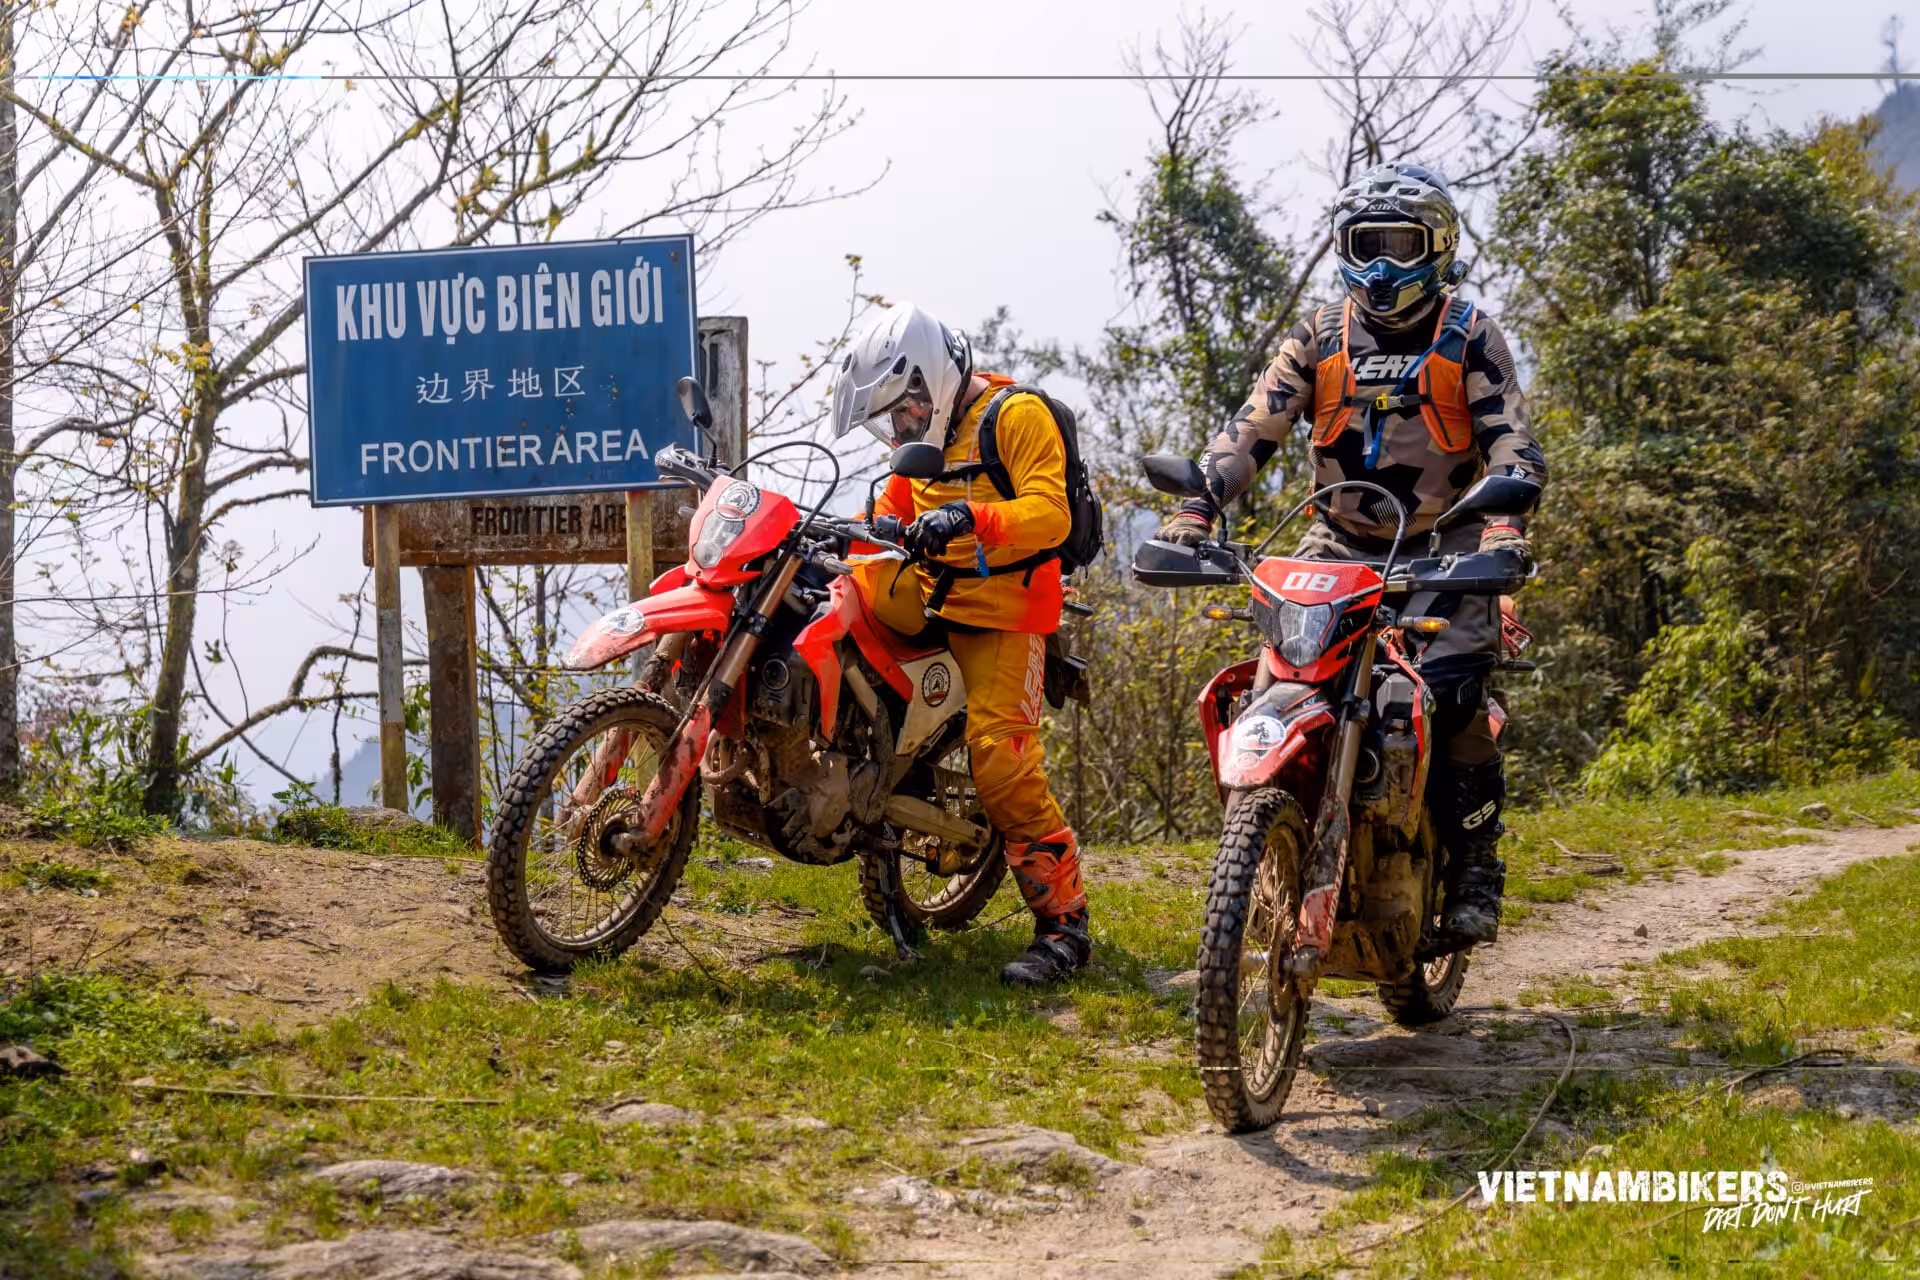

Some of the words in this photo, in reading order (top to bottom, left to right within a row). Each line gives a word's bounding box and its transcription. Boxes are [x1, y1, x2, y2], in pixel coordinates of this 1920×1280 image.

[336, 281, 407, 342] KHU
[416, 272, 486, 345] VỰC
[496, 262, 581, 332] BIÊN
[590, 256, 663, 327] GIỚI
[416, 365, 586, 404] 边界地区
[361, 435, 544, 475] FRONTIER
[550, 428, 649, 465] AREA
[471, 504, 582, 537] FRONTIER
[589, 503, 627, 537] ARE
[1281, 572, 1339, 593] 08
[1462, 800, 1497, 831] GS
